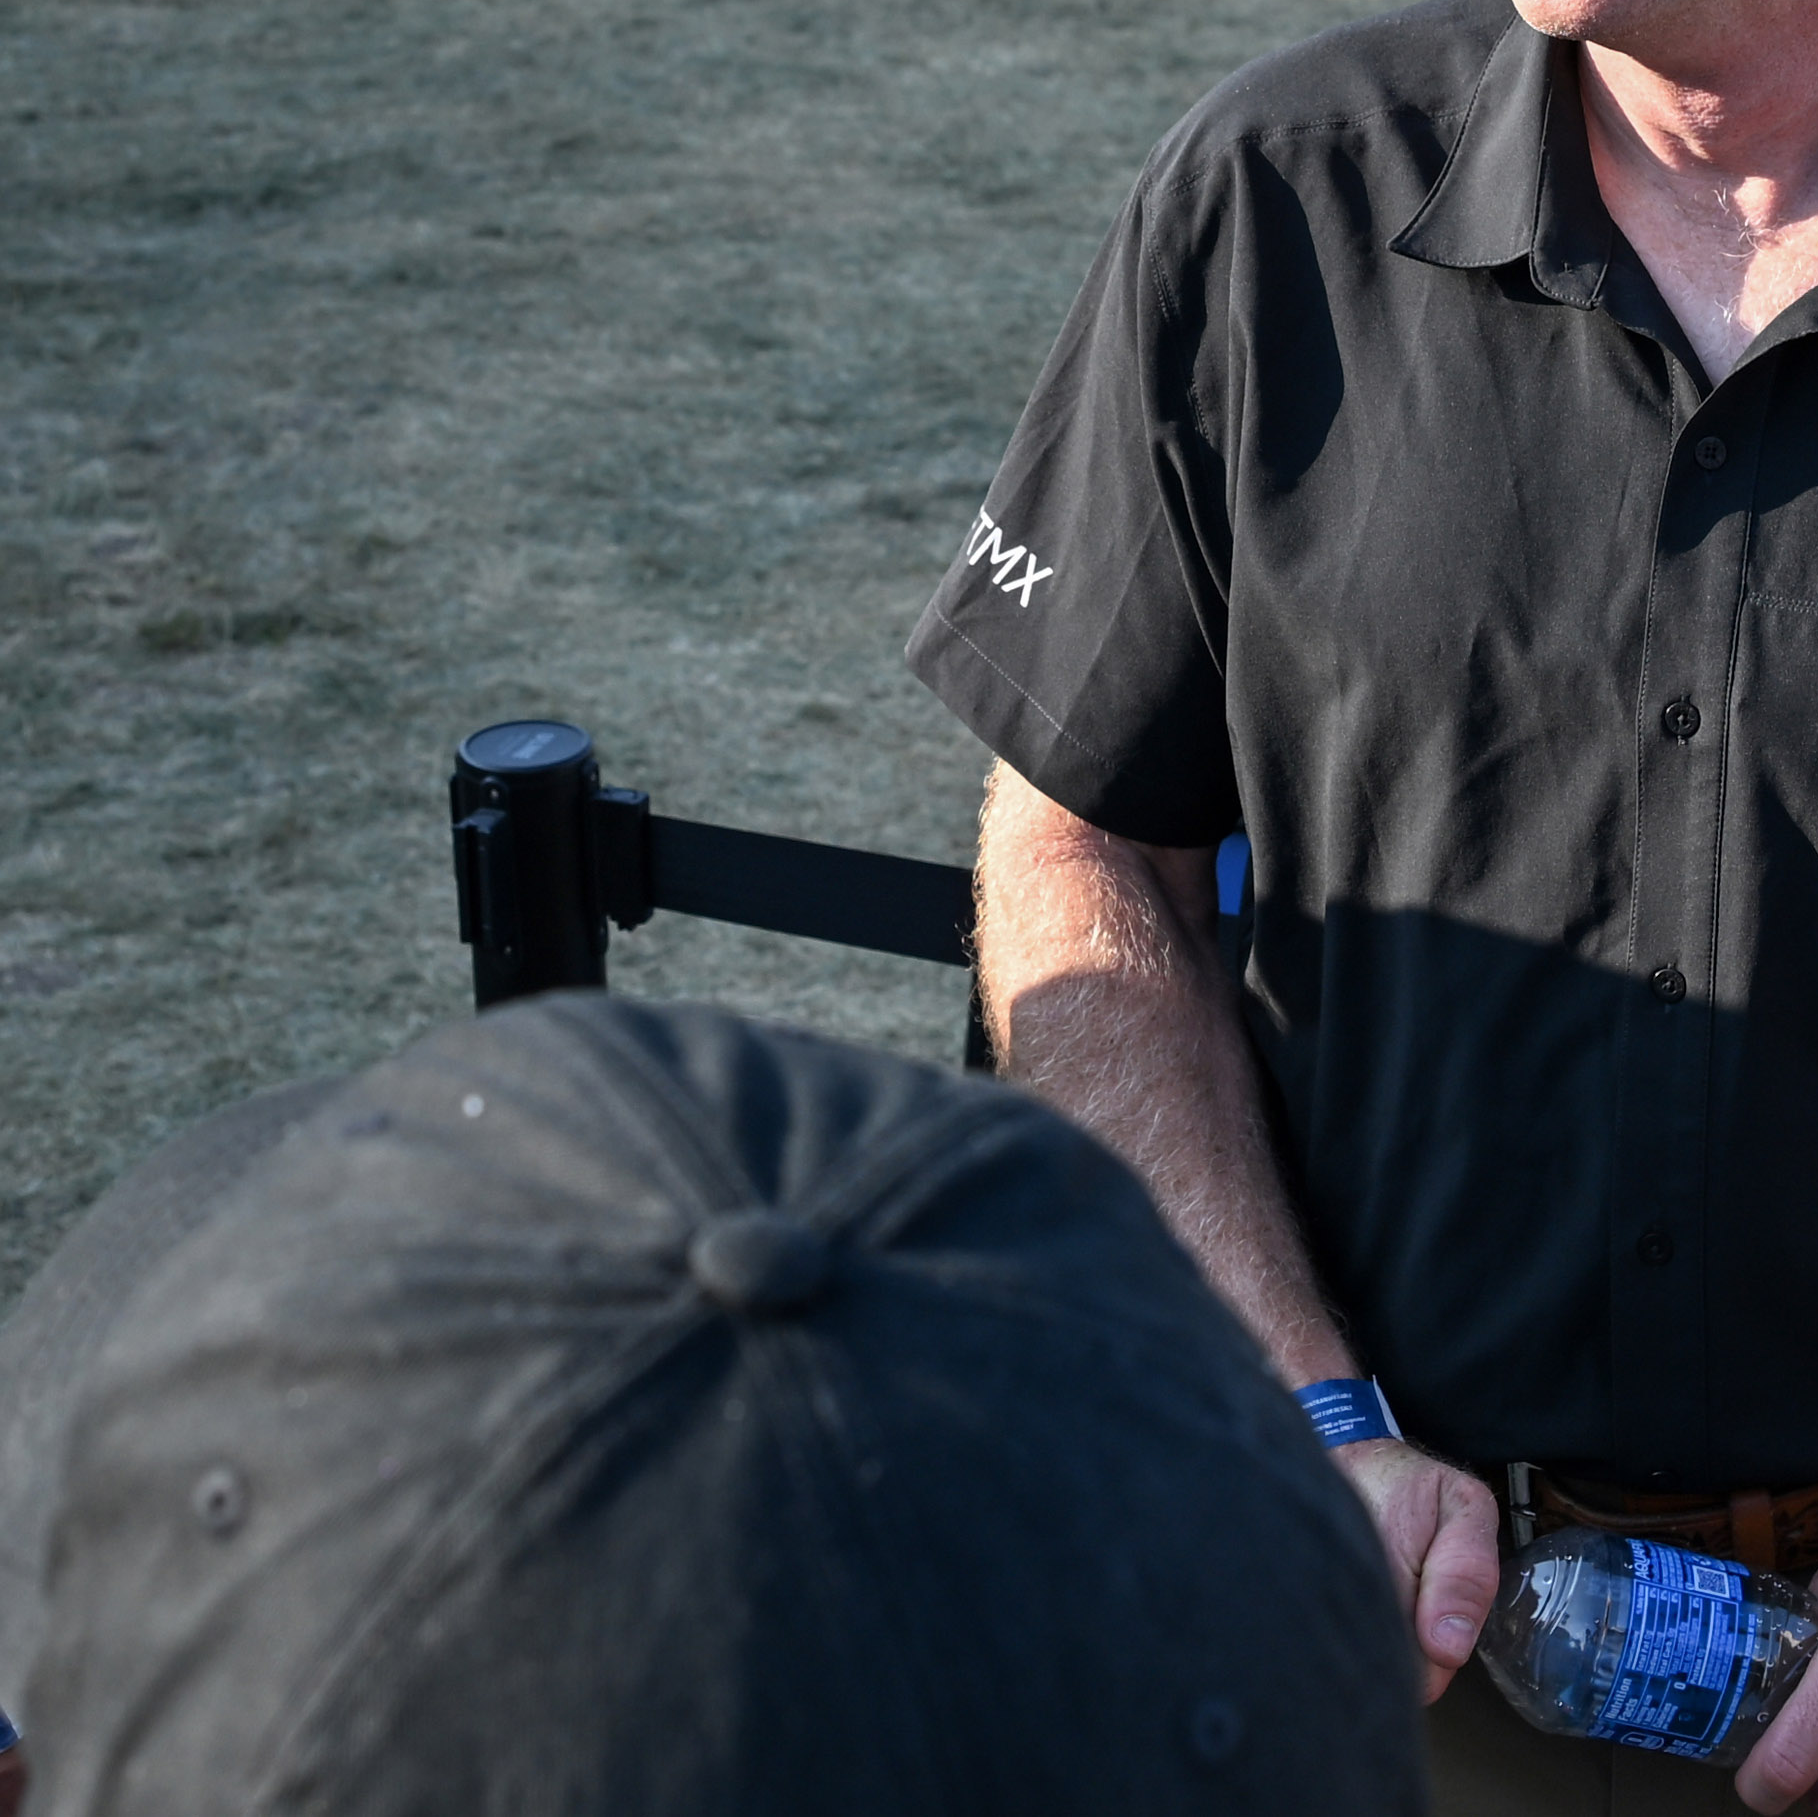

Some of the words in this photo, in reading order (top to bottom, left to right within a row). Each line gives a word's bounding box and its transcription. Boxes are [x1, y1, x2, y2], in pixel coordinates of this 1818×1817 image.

[966, 504, 1053, 608] TMX
[1604, 1677, 1633, 1720] Nutrition
[1673, 1681, 1686, 1691] 0
[1618, 1698, 1639, 1722] Facts
